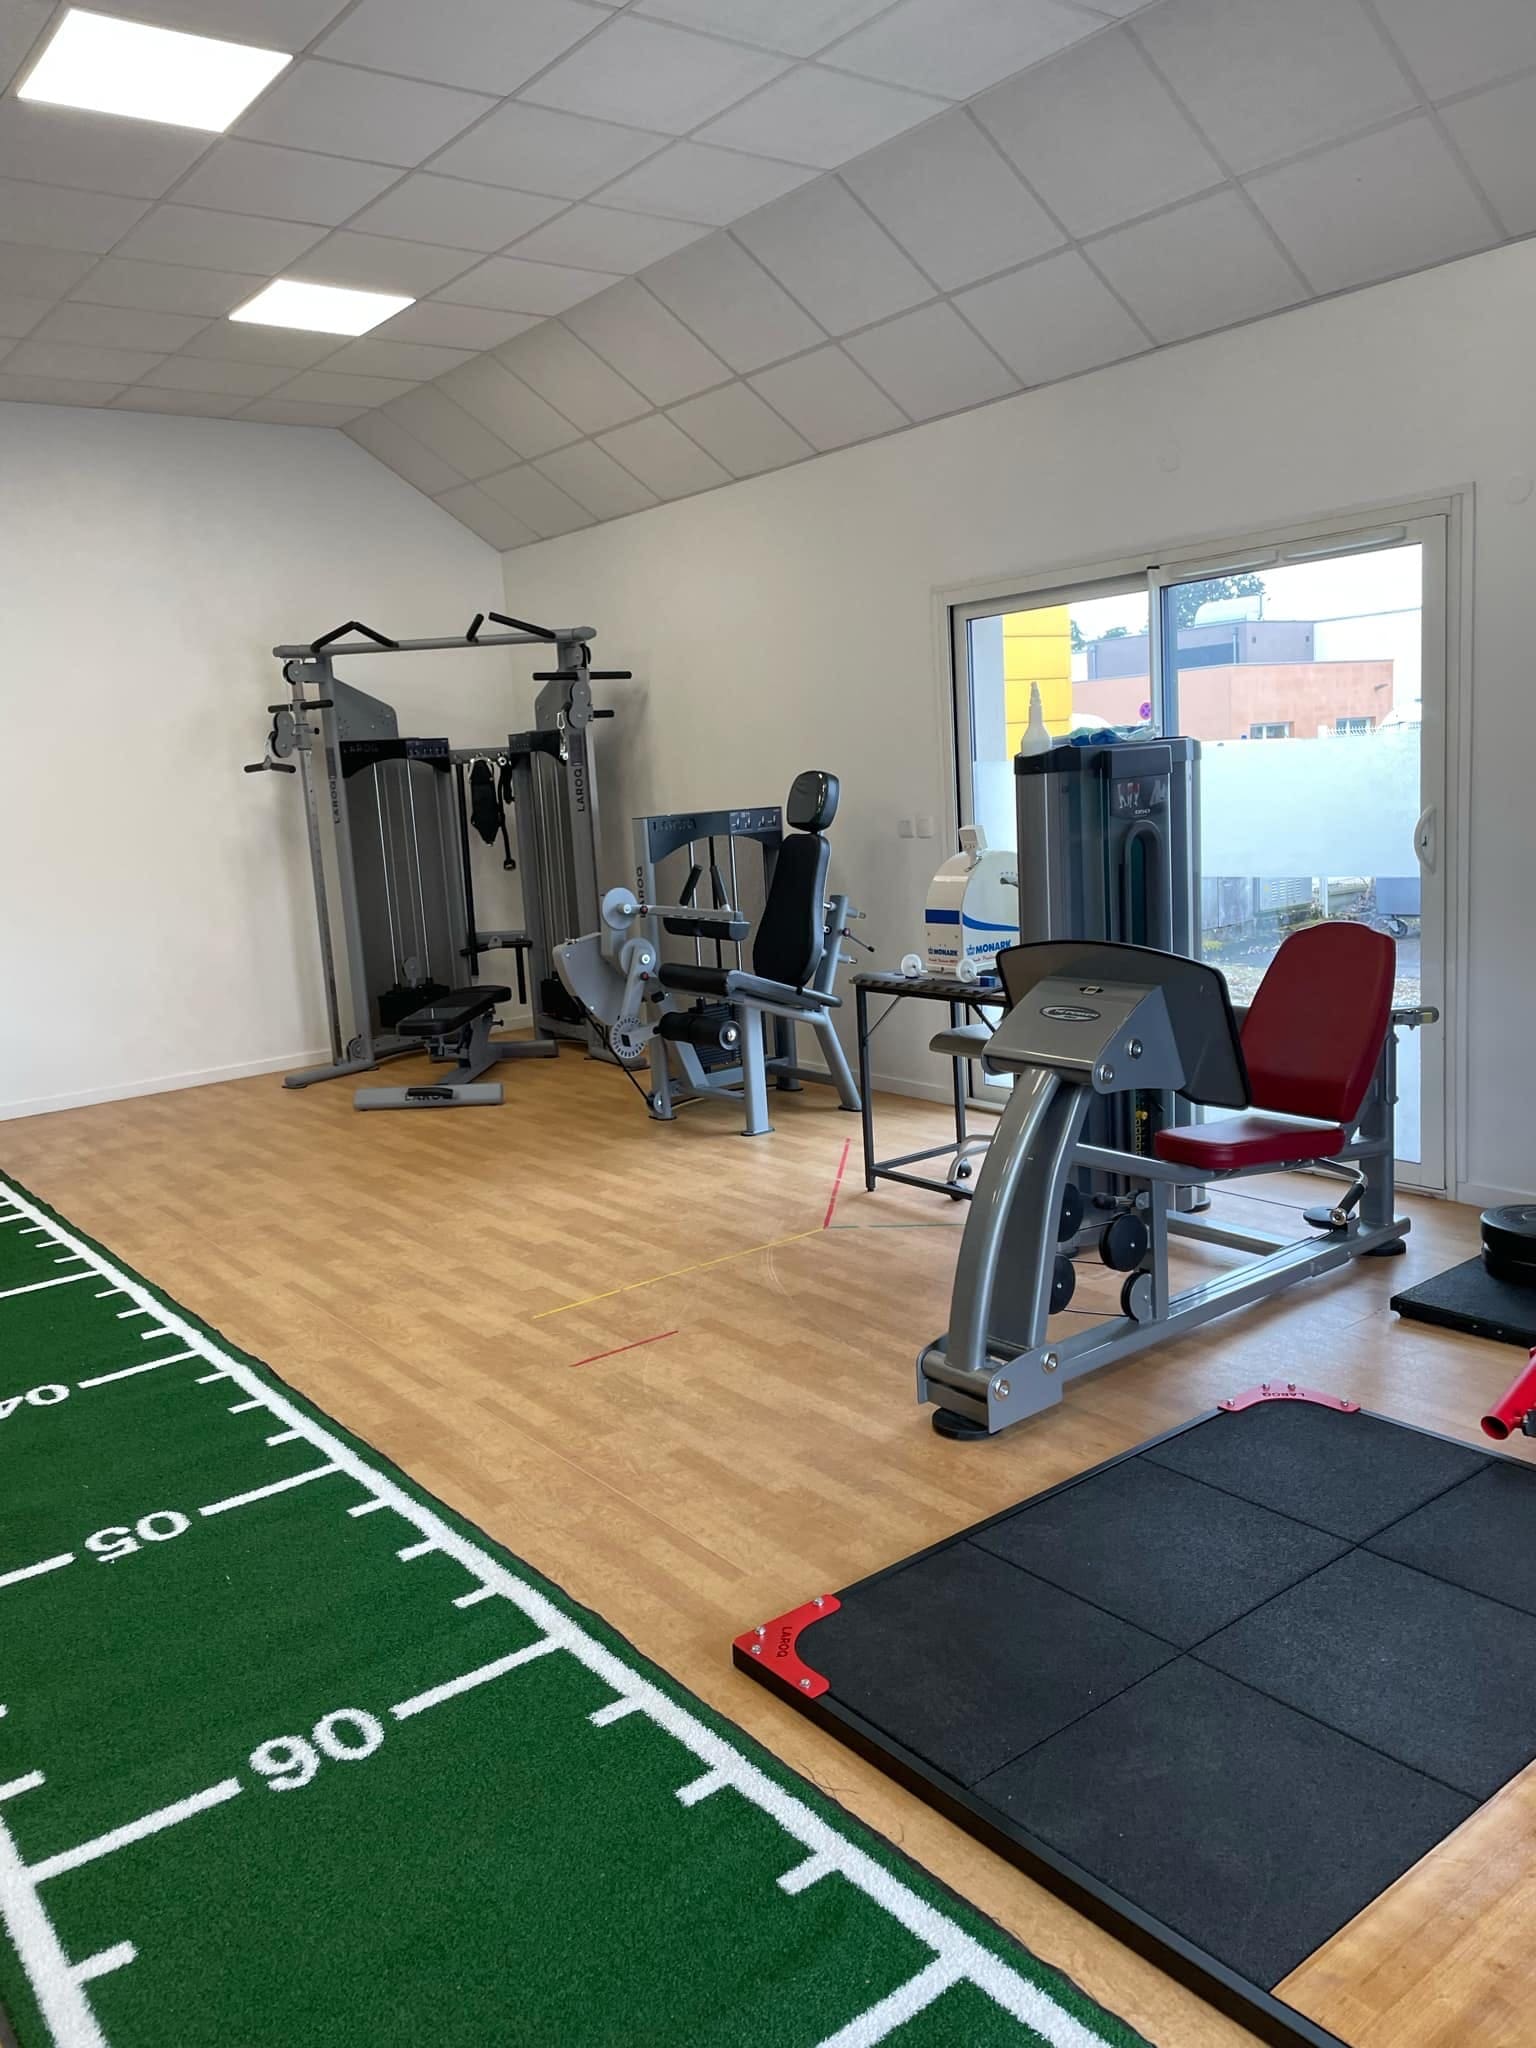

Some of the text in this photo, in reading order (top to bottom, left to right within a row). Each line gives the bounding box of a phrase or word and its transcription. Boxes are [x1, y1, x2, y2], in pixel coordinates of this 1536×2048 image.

[574, 767, 586, 813] LAROQ
[975, 939, 1012, 955] MONARK
[776, 1626, 793, 1658] LAROQ
